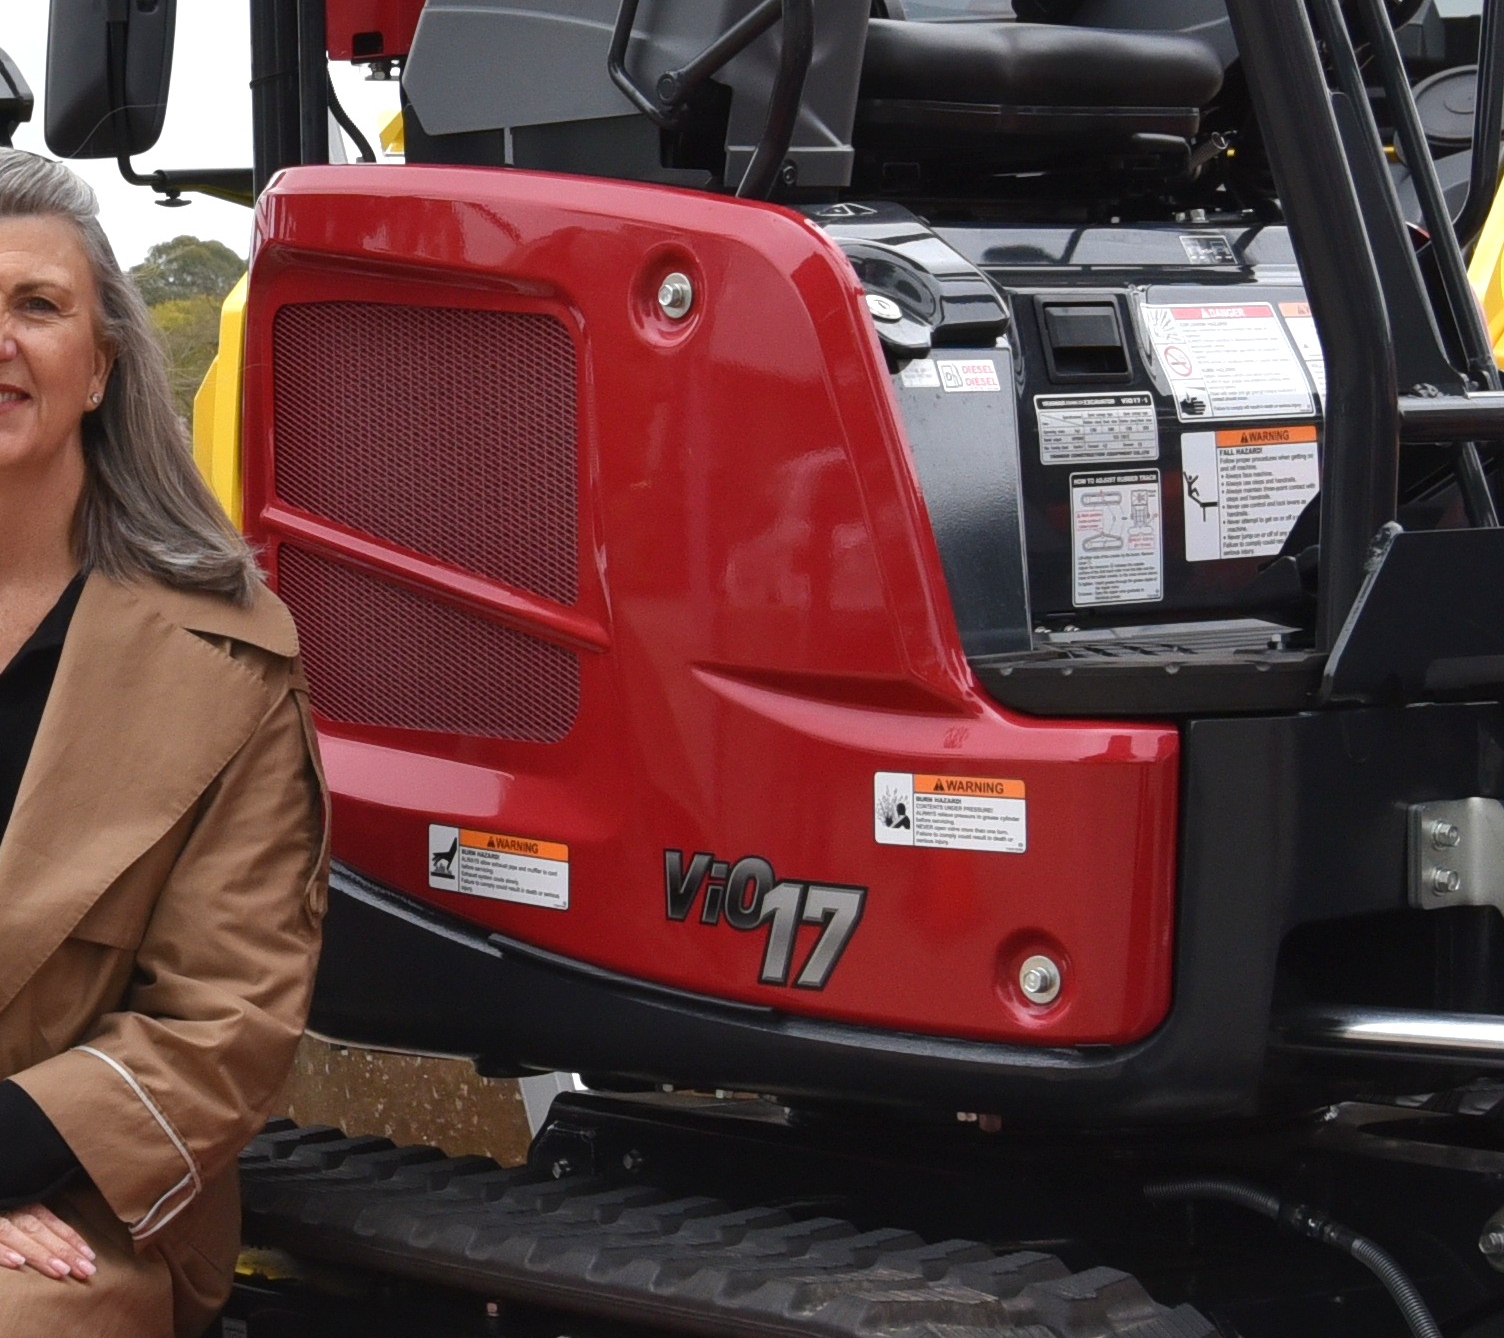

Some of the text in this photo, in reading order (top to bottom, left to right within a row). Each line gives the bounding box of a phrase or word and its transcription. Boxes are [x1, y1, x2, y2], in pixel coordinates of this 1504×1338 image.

[961, 365, 994, 374] DIESEL
[965, 377, 998, 386] DIESEL
[1248, 430, 1290, 442] WARNING
[946, 780, 1004, 794] WARNING
[495, 837, 539, 854] WARNING
